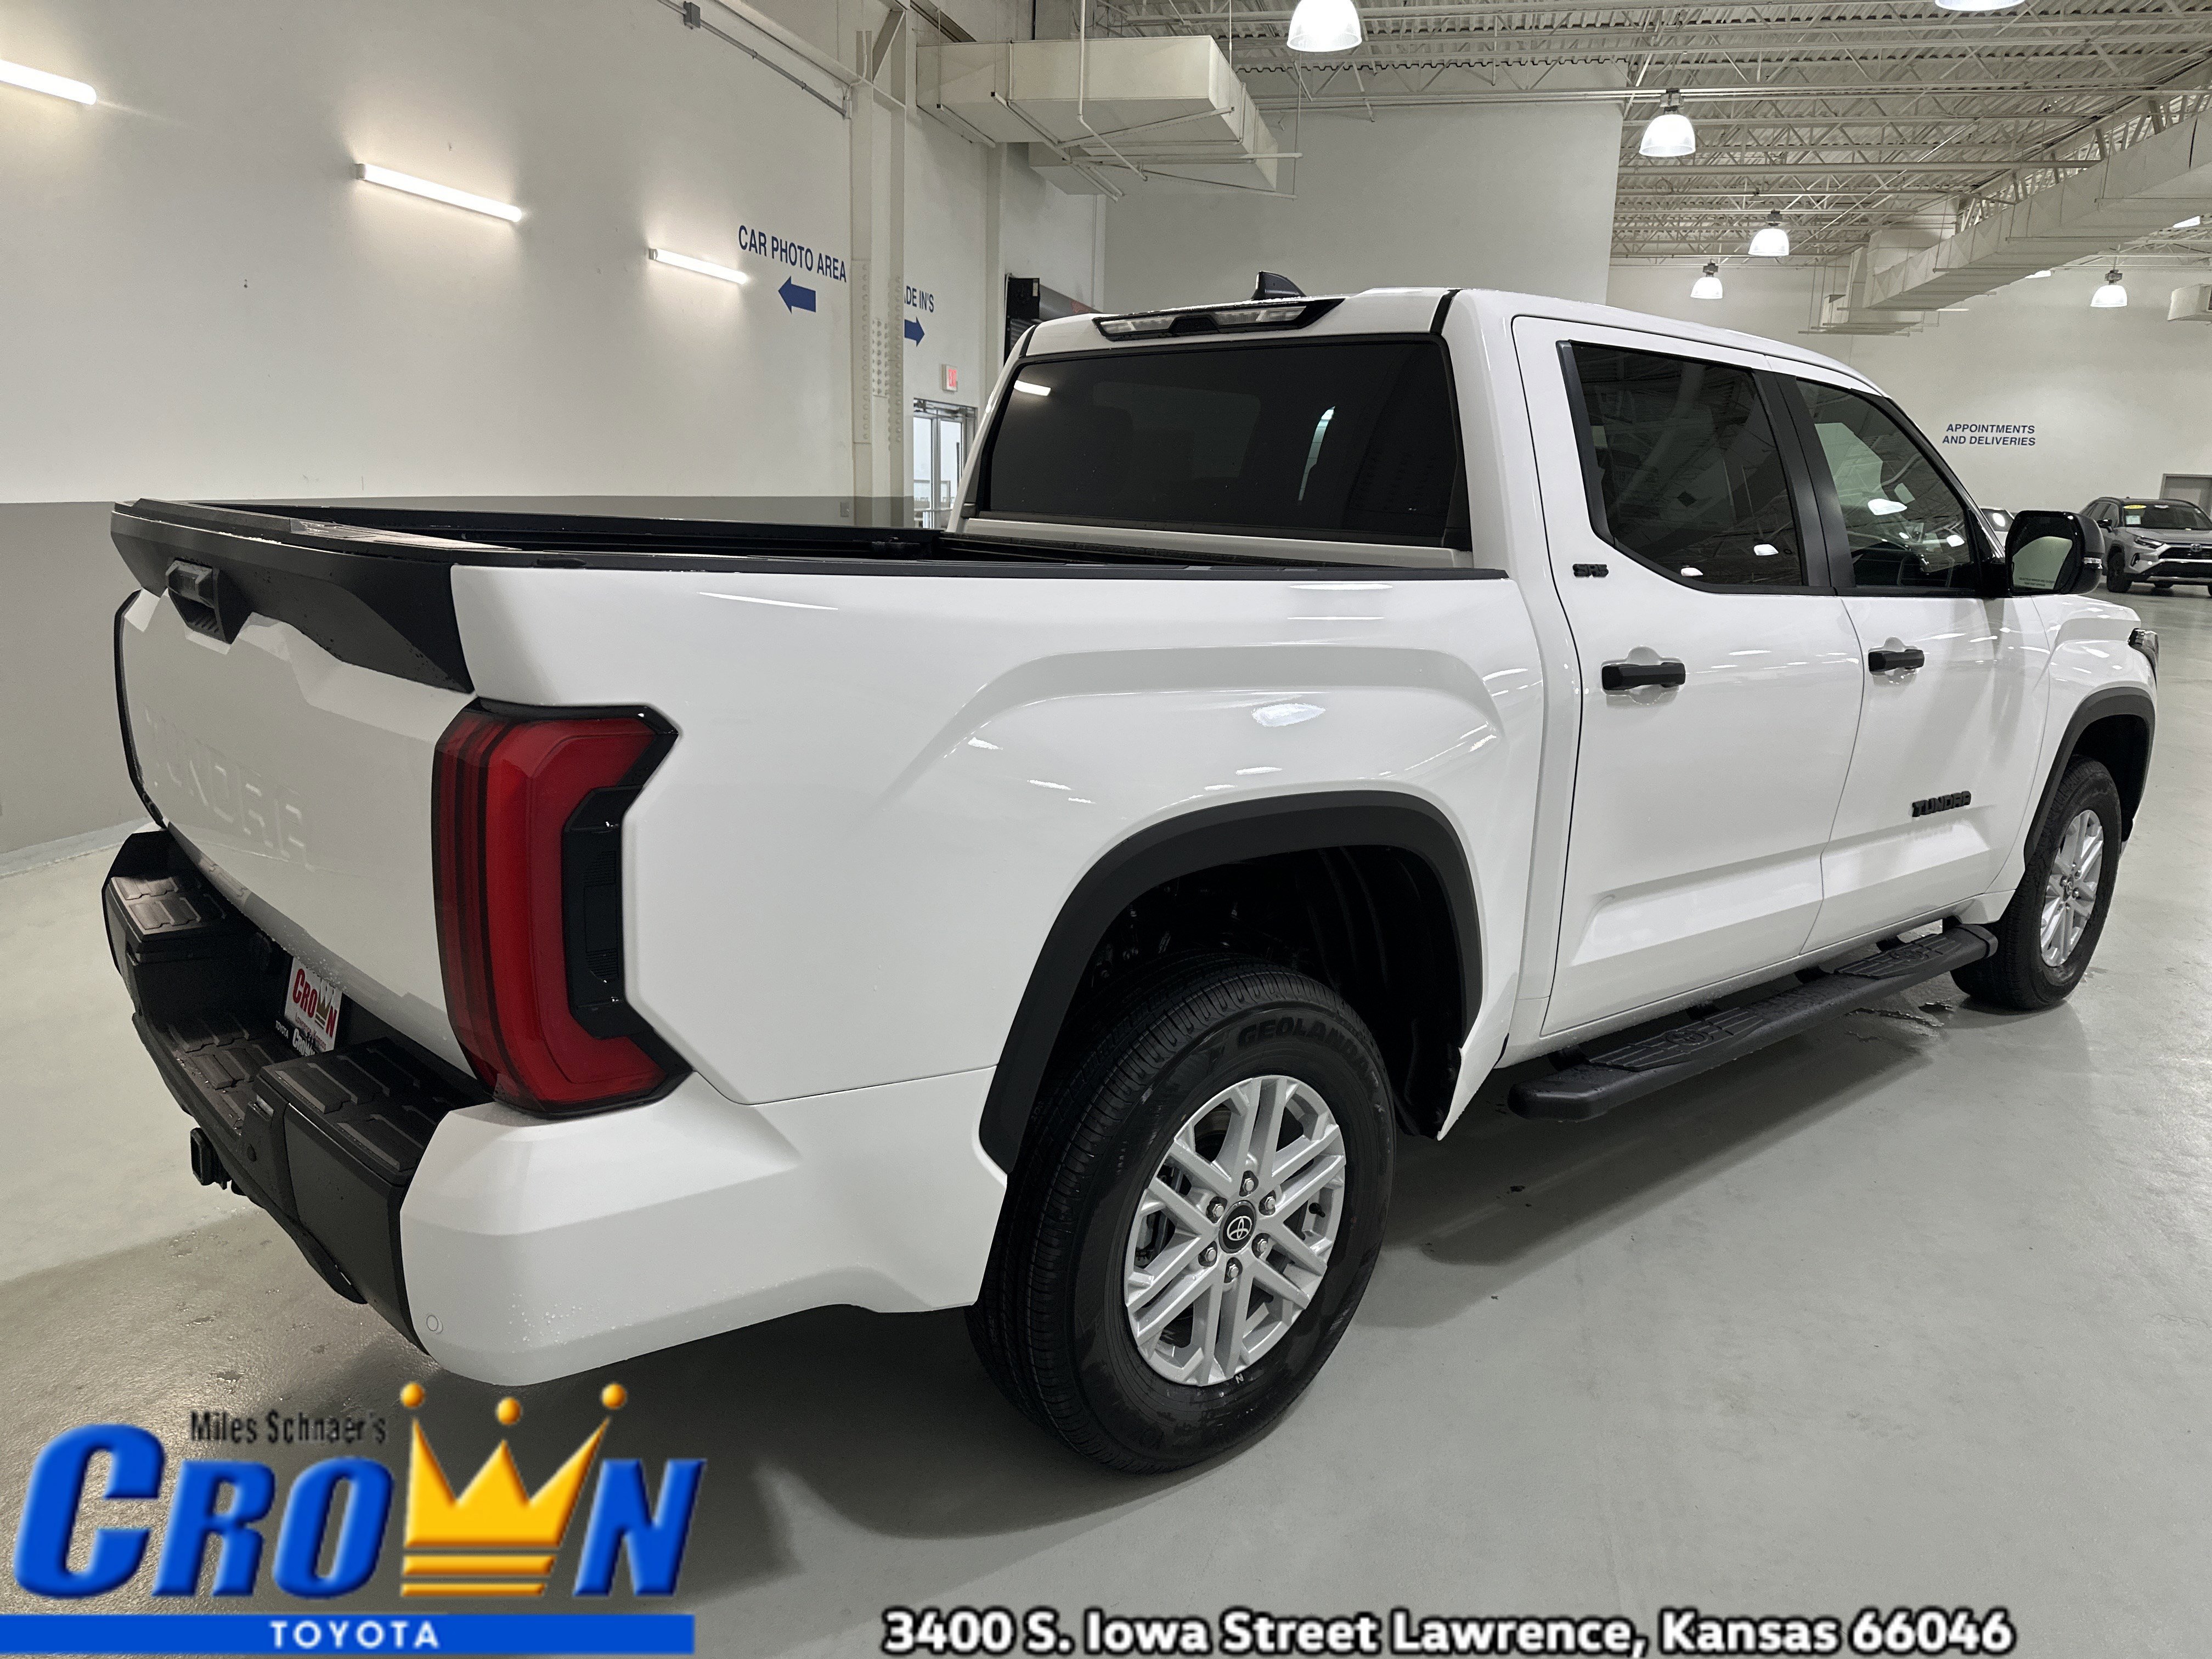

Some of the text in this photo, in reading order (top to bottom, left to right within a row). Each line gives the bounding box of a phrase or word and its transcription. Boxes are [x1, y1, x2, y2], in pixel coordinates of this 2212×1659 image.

[738, 225, 847, 283] CAR PHOTO AREA
[919, 290, 934, 313] IN'S
[1946, 424, 2035, 434] APPOINTMENTS
[1942, 436, 2036, 446] AND DELIVERIES
[1572, 563, 1609, 577] SR5
[1911, 791, 1972, 817] TUNDRA
[292, 968, 338, 1039] CROWN
[275, 1020, 289, 1039] TOYOTA
